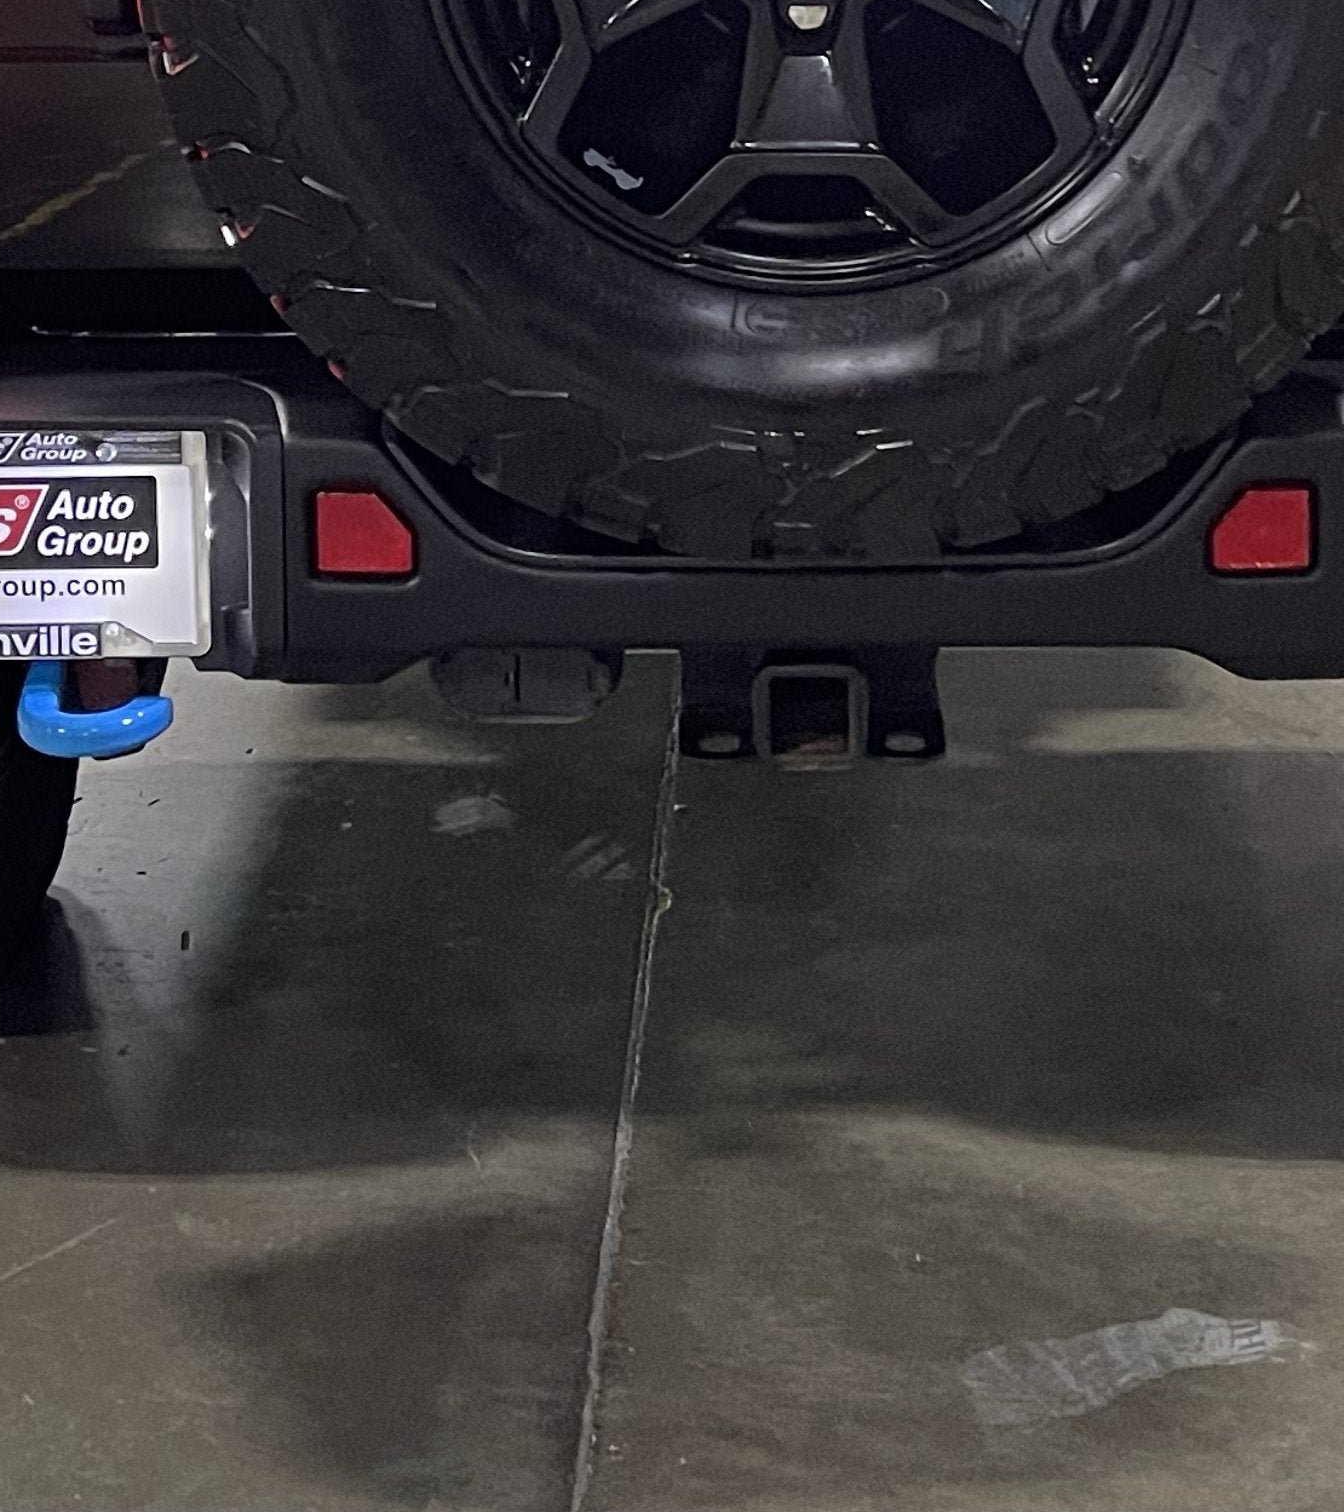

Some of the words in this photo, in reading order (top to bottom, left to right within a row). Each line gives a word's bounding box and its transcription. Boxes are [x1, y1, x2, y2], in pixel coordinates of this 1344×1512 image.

[24, 432, 78, 446] Auto
[20, 446, 87, 462] Group
[47, 489, 134, 521] Auto
[37, 525, 150, 563] Group
